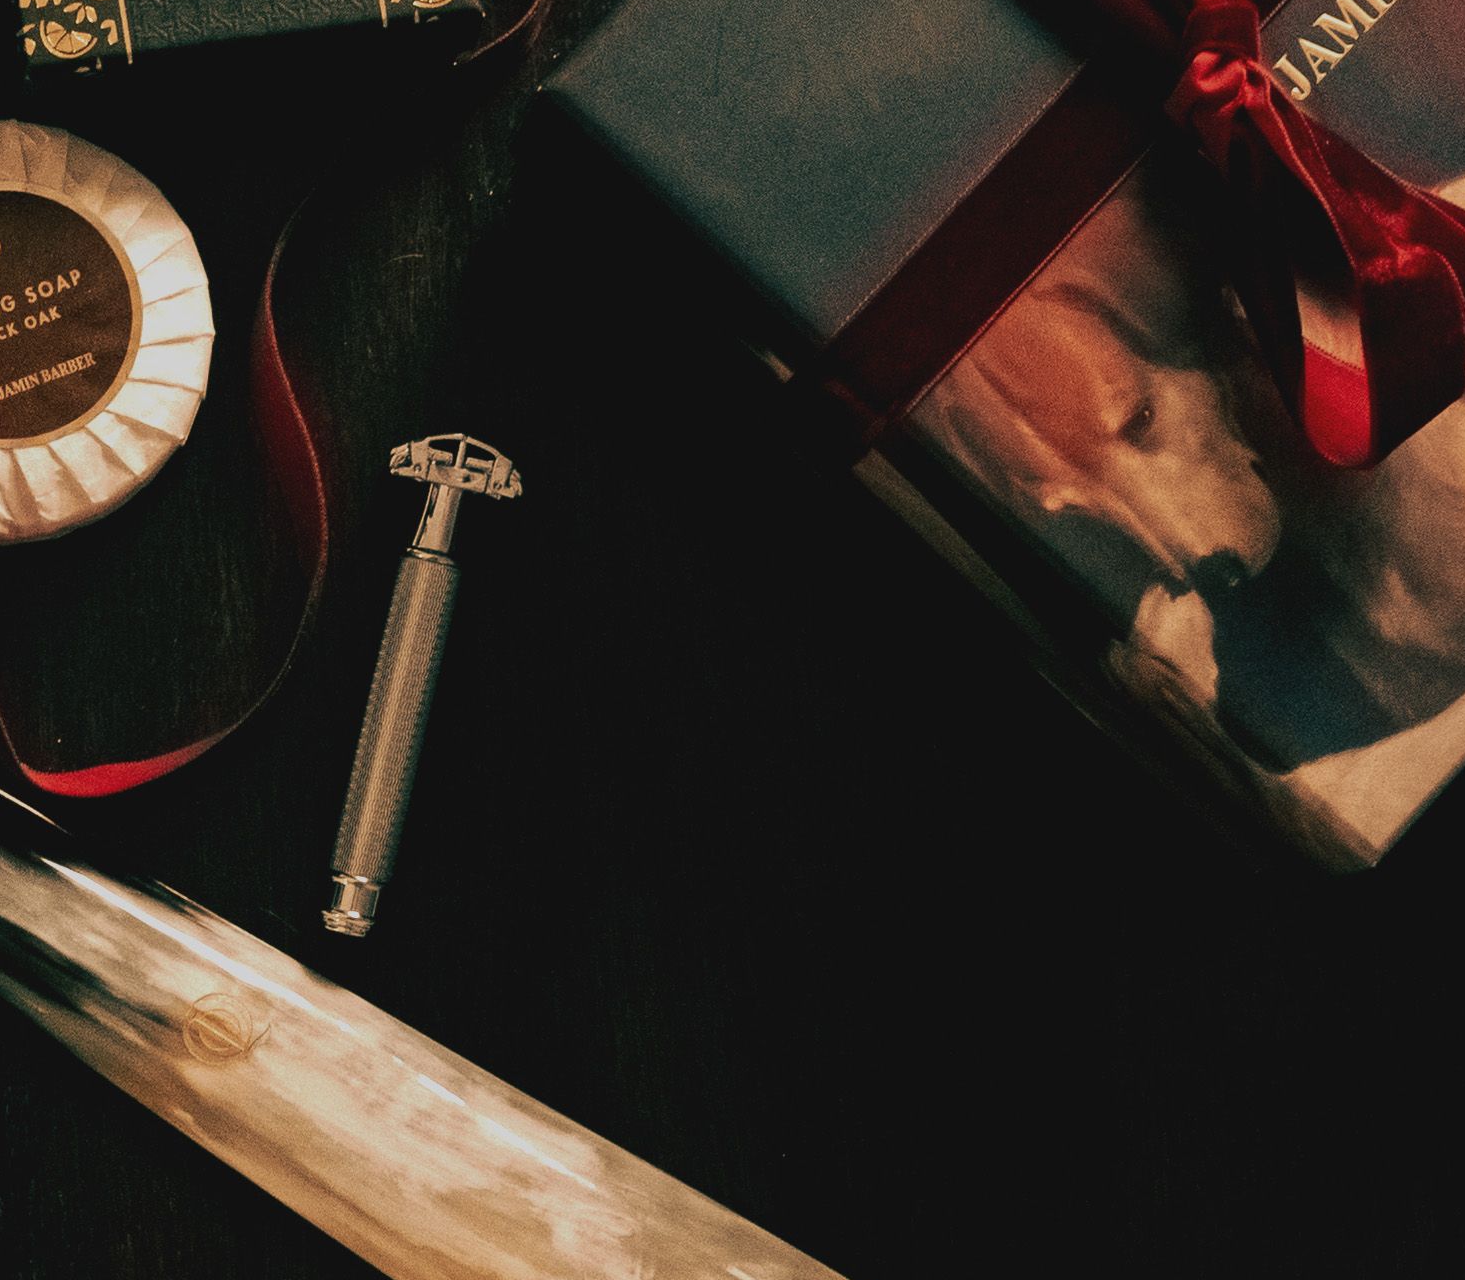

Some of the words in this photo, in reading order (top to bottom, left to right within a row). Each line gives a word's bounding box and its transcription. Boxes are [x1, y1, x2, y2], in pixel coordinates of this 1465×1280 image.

[24, 269, 82, 304] SOAP
[23, 305, 62, 329] OAK
[41, 351, 97, 382] BARBER
